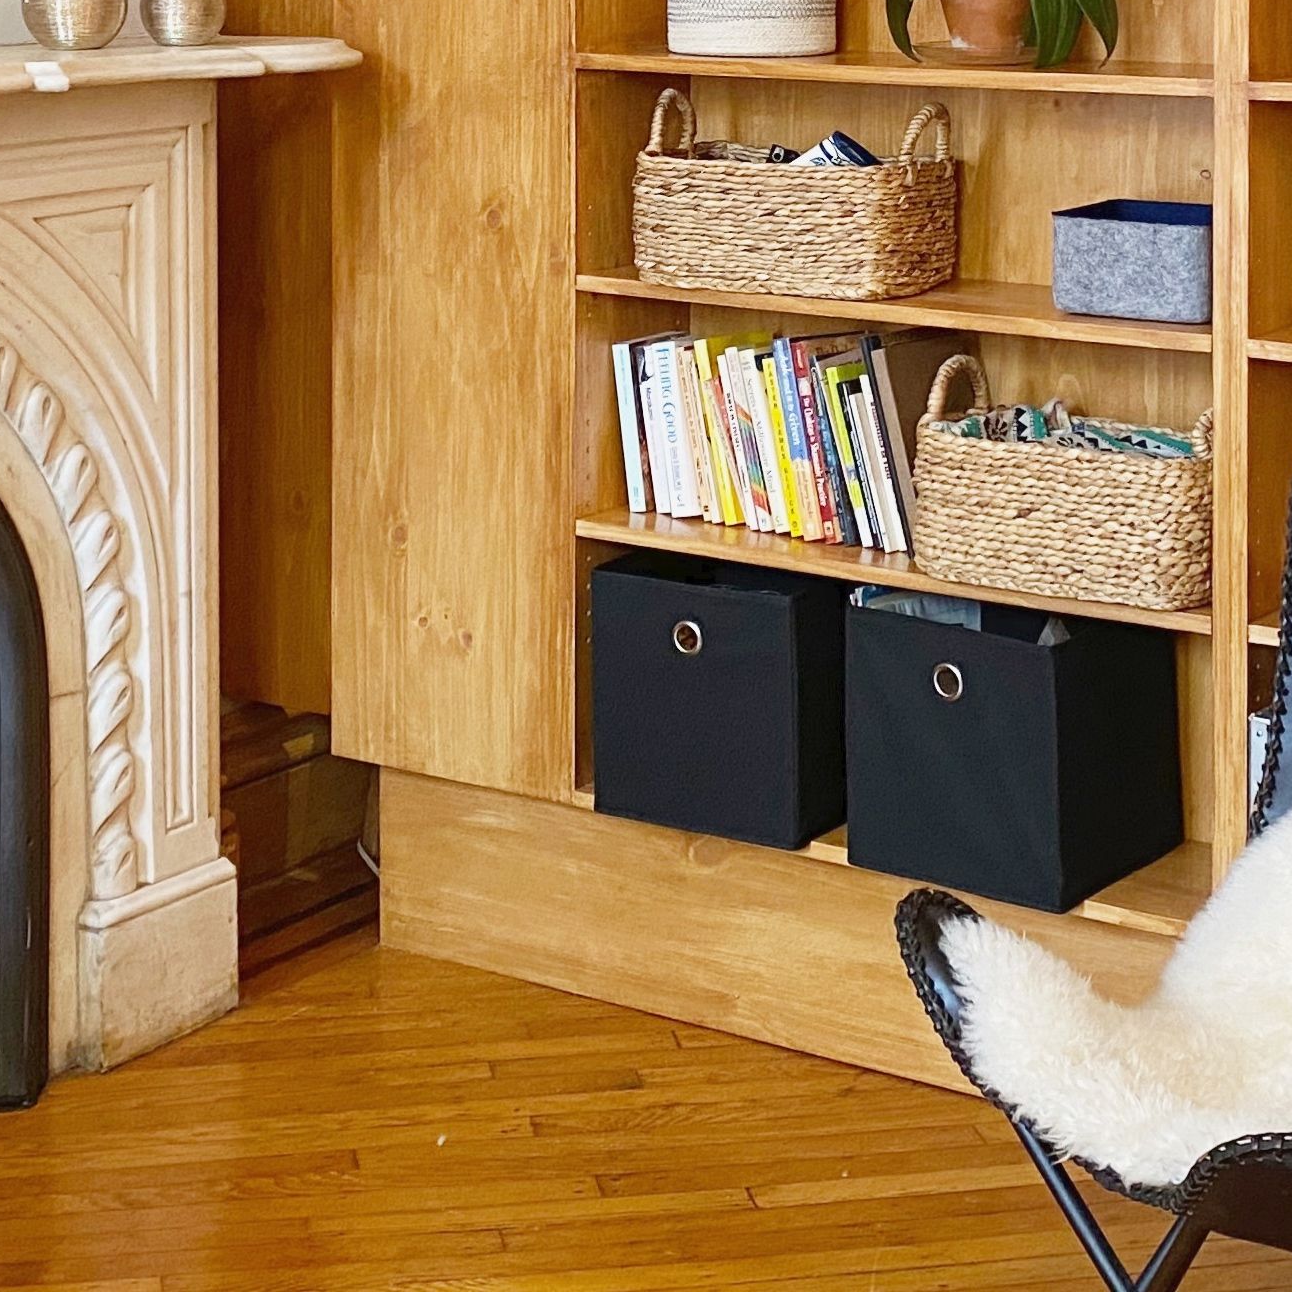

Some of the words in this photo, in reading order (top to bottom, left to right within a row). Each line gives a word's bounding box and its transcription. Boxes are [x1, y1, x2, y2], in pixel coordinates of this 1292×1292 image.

[655, 347, 676, 399] FEELING
[661, 401, 680, 444] GOOD
[766, 362, 778, 408] FASTER
[775, 420, 787, 460] JAMES
[787, 412, 802, 446] Given
[745, 377, 759, 407] Secrets
[764, 469, 777, 493] Mind
[814, 477, 827, 507] Practice
